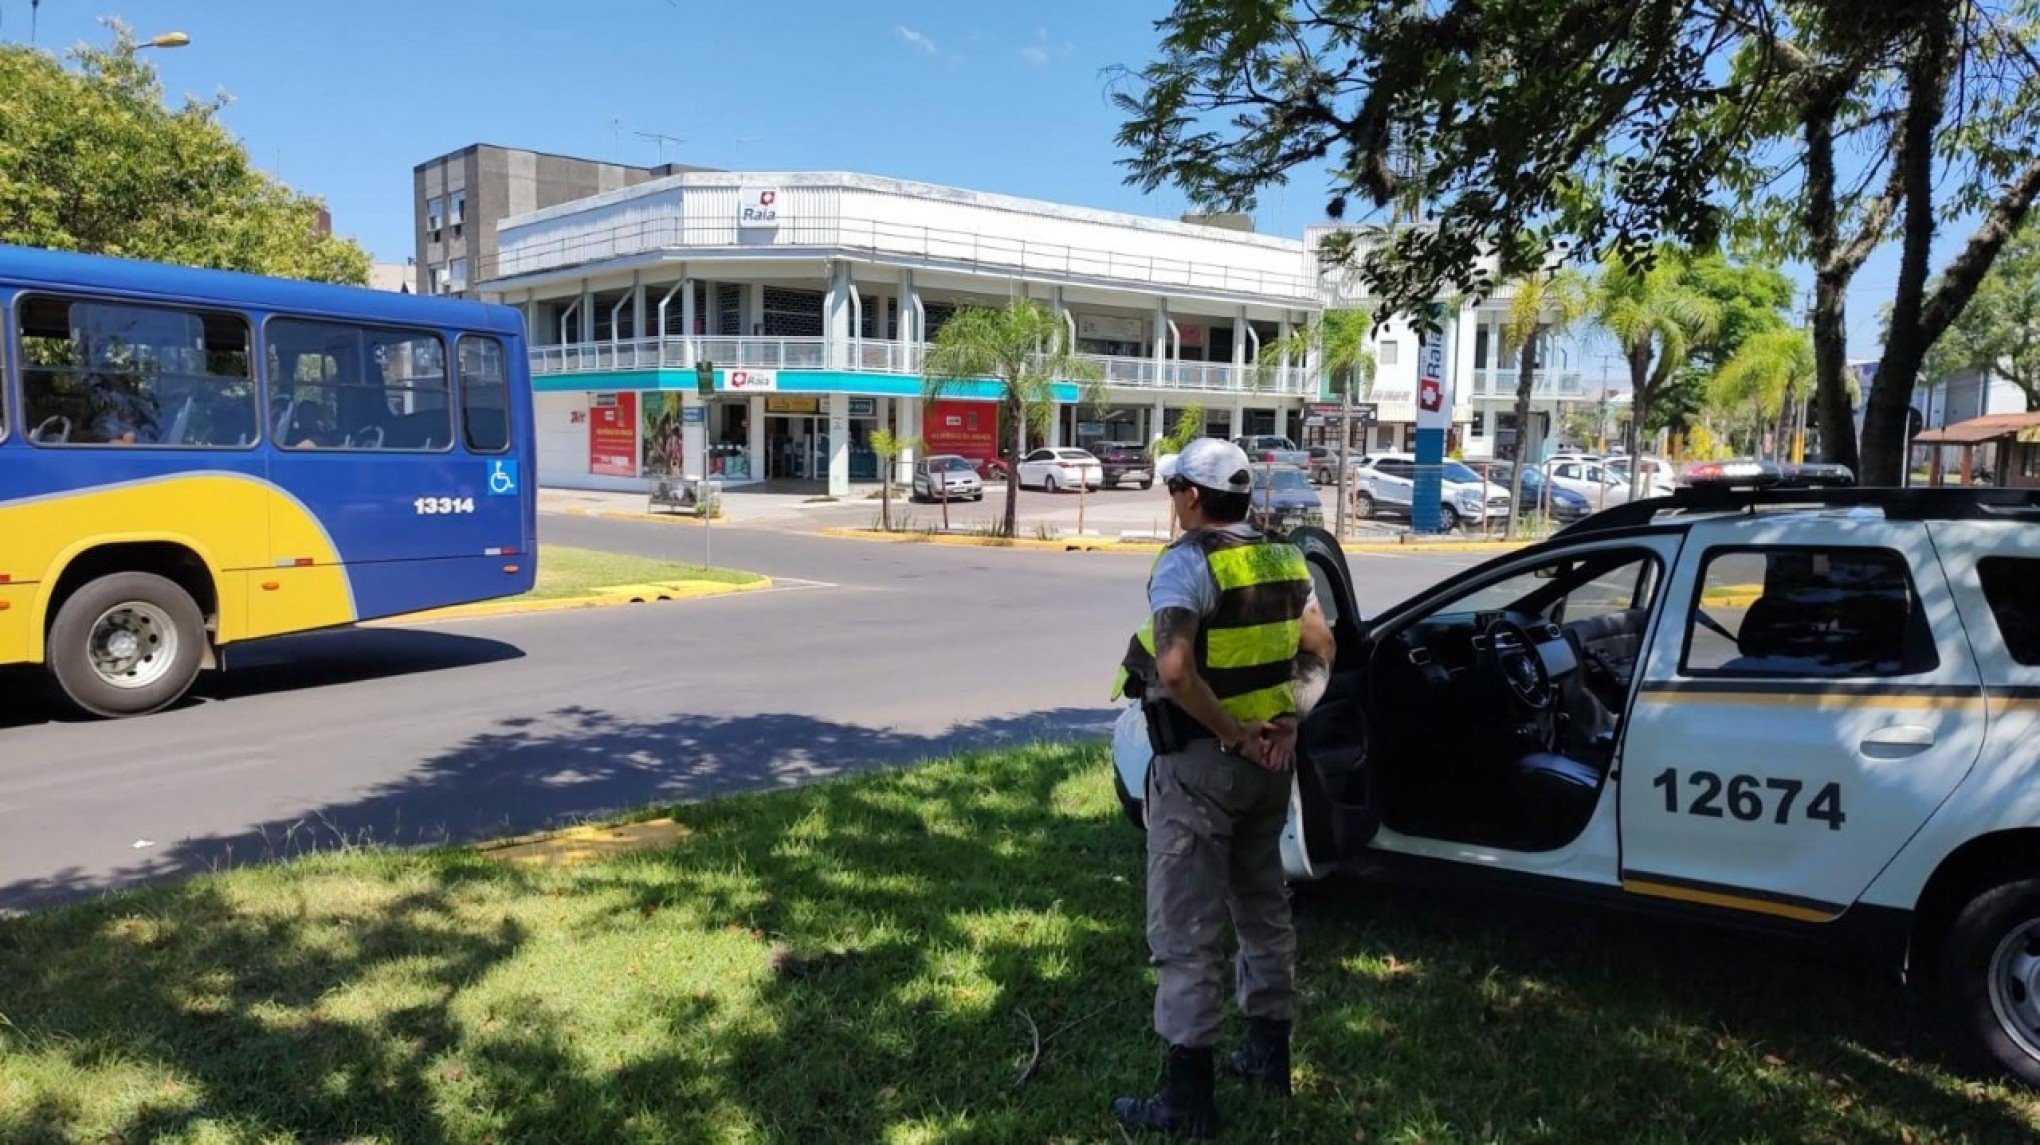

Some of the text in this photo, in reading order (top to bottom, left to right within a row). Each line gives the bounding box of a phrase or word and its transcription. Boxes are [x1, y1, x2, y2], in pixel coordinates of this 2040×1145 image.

[743, 208, 776, 221] Raia
[748, 376, 770, 386] Raia
[414, 497, 475, 515] 13314
[1653, 767, 1846, 831] 12674
